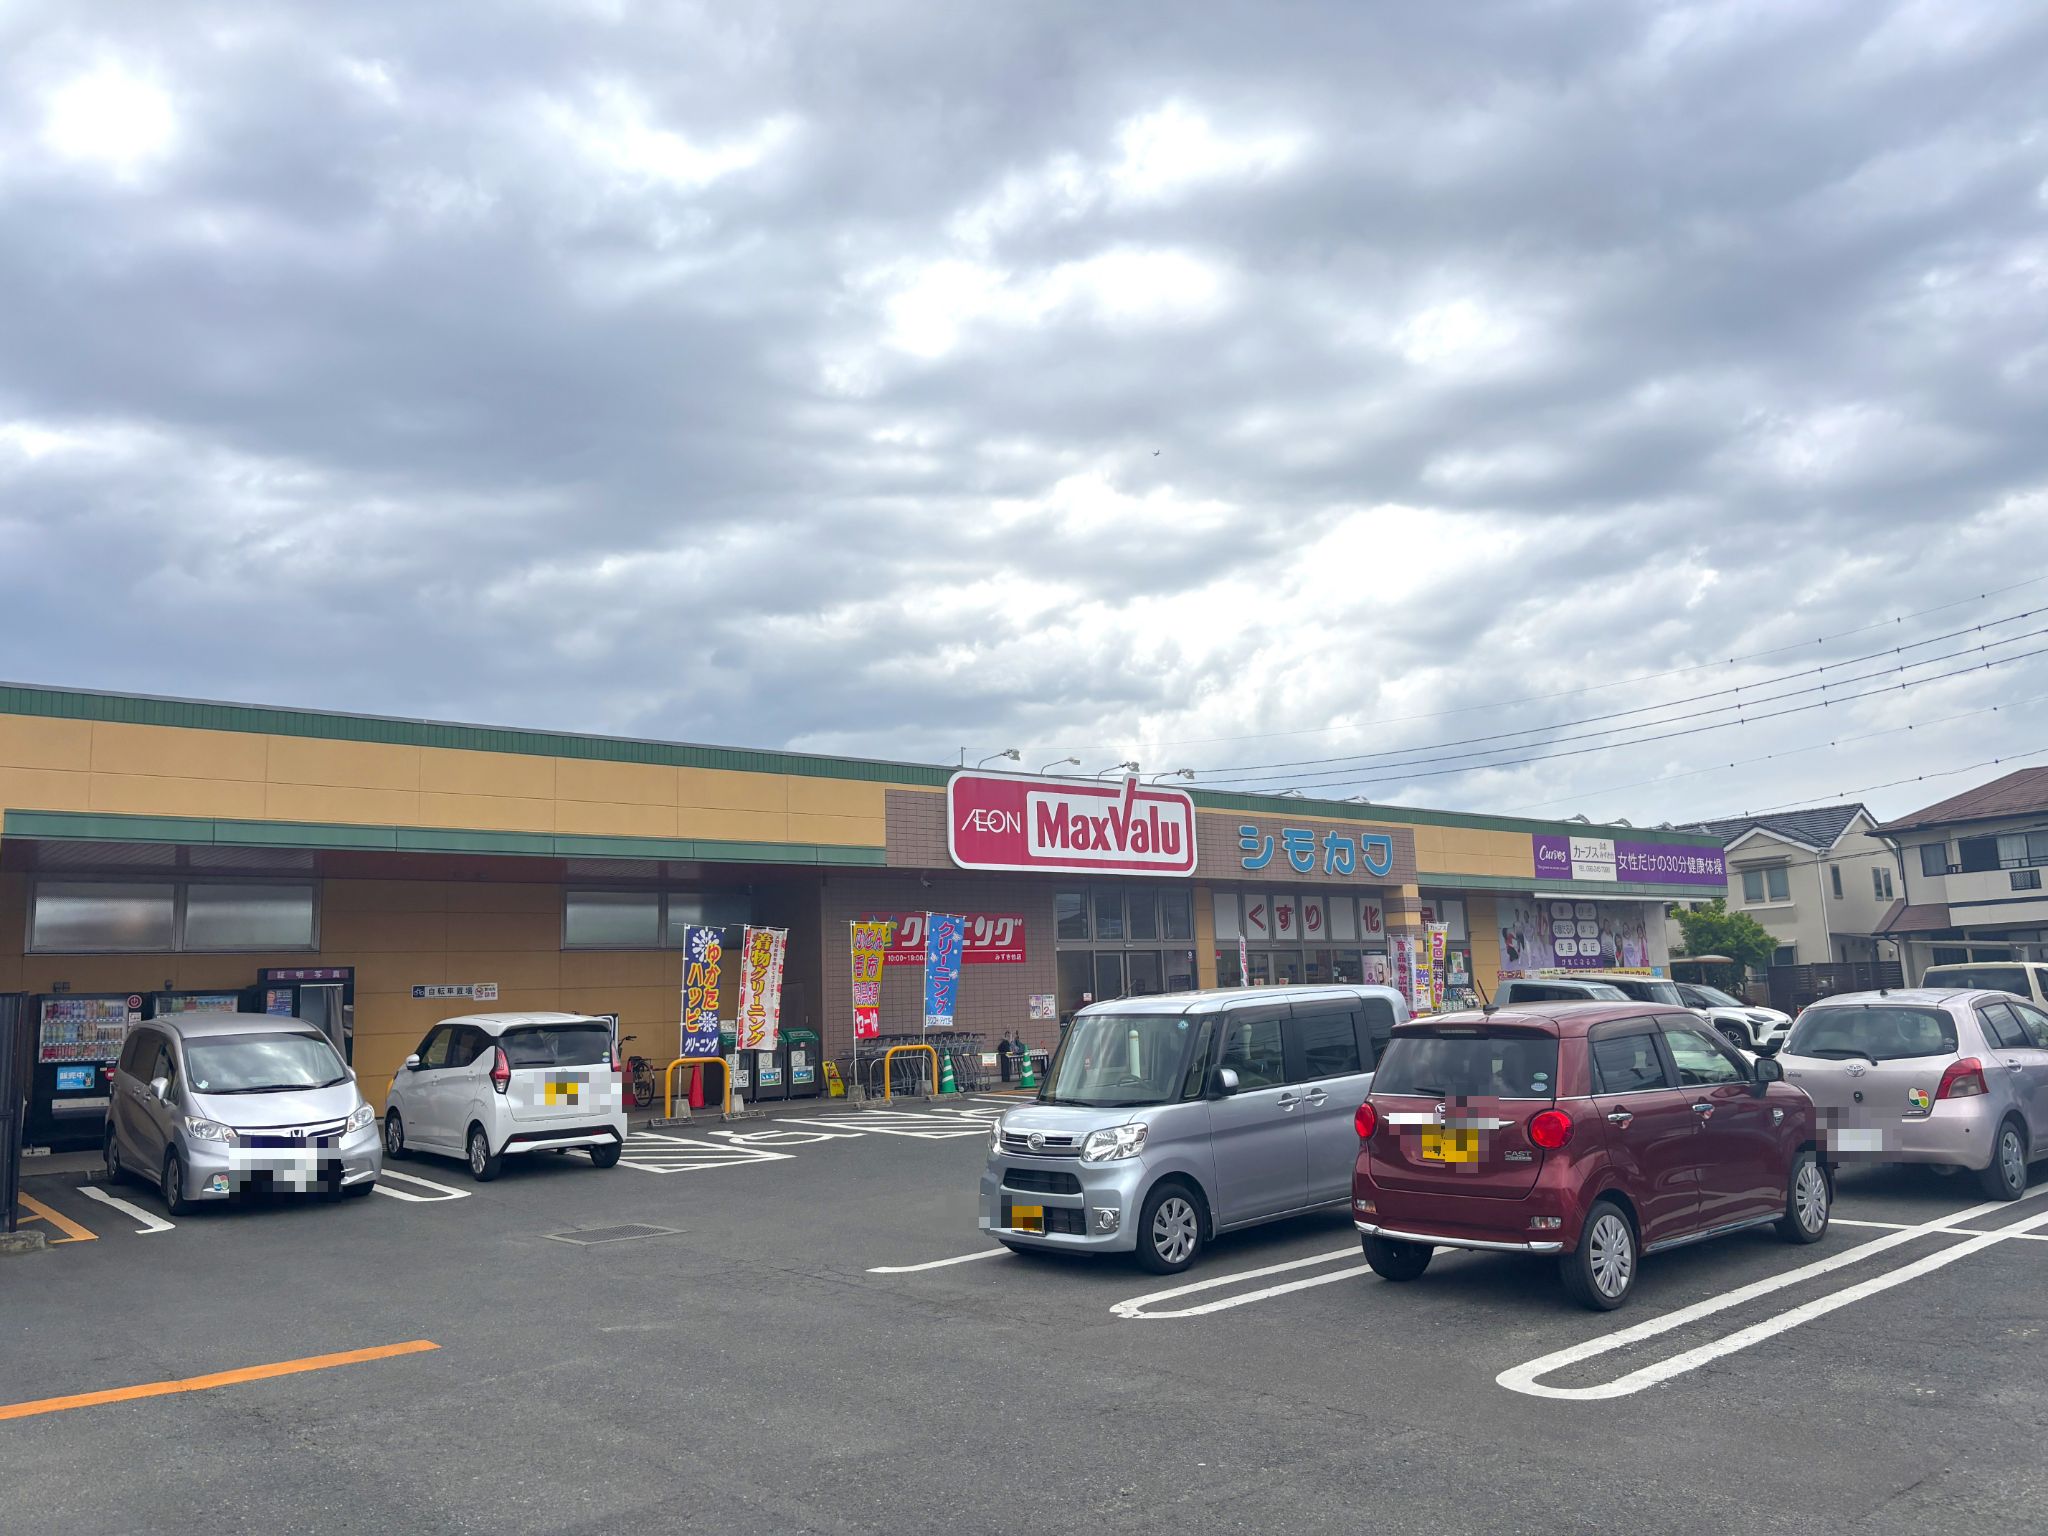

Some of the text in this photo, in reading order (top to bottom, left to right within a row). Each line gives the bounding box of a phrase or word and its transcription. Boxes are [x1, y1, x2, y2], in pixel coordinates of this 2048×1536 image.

[1036, 778, 1181, 855] MaxValu
[1239, 825, 1394, 877] シモカワ
[1539, 844, 1567, 863] Curves
[1573, 844, 1599, 859] カーブス
[1617, 852, 1724, 876] 女性だけの30分健康体操
[1248, 904, 1322, 931] くすり
[855, 928, 883, 951] ふとん
[704, 944, 721, 1010] ゆかた
[855, 954, 879, 978] 毛布
[934, 920, 954, 1015] クリーニング
[428, 987, 473, 996] 自転車置場
[686, 962, 704, 1032] ハッピ
[746, 933, 773, 1047] 着物クリーニング
[685, 1037, 719, 1053] クリーニング
